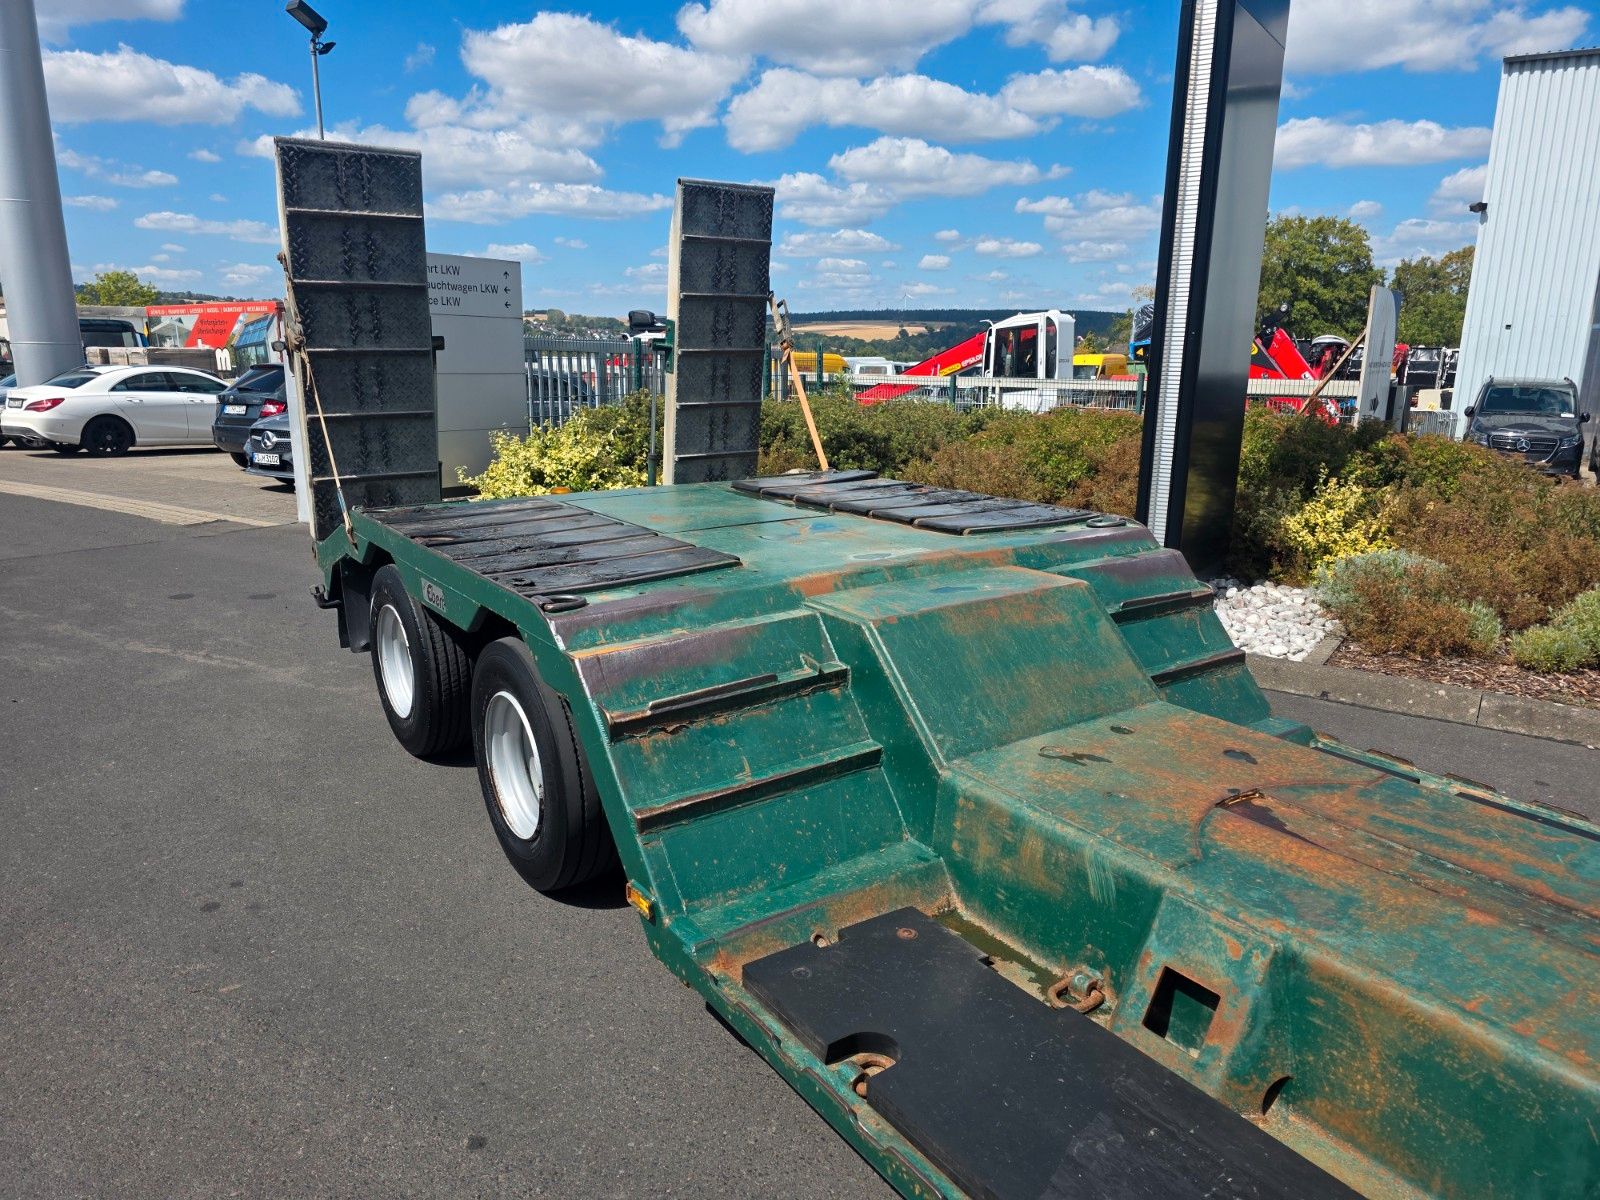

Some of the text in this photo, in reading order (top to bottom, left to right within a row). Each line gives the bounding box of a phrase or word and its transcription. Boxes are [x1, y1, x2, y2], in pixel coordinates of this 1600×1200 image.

[441, 265, 460, 276] LKW
[480, 283, 499, 294] LKW
[441, 296, 460, 307] LKW
